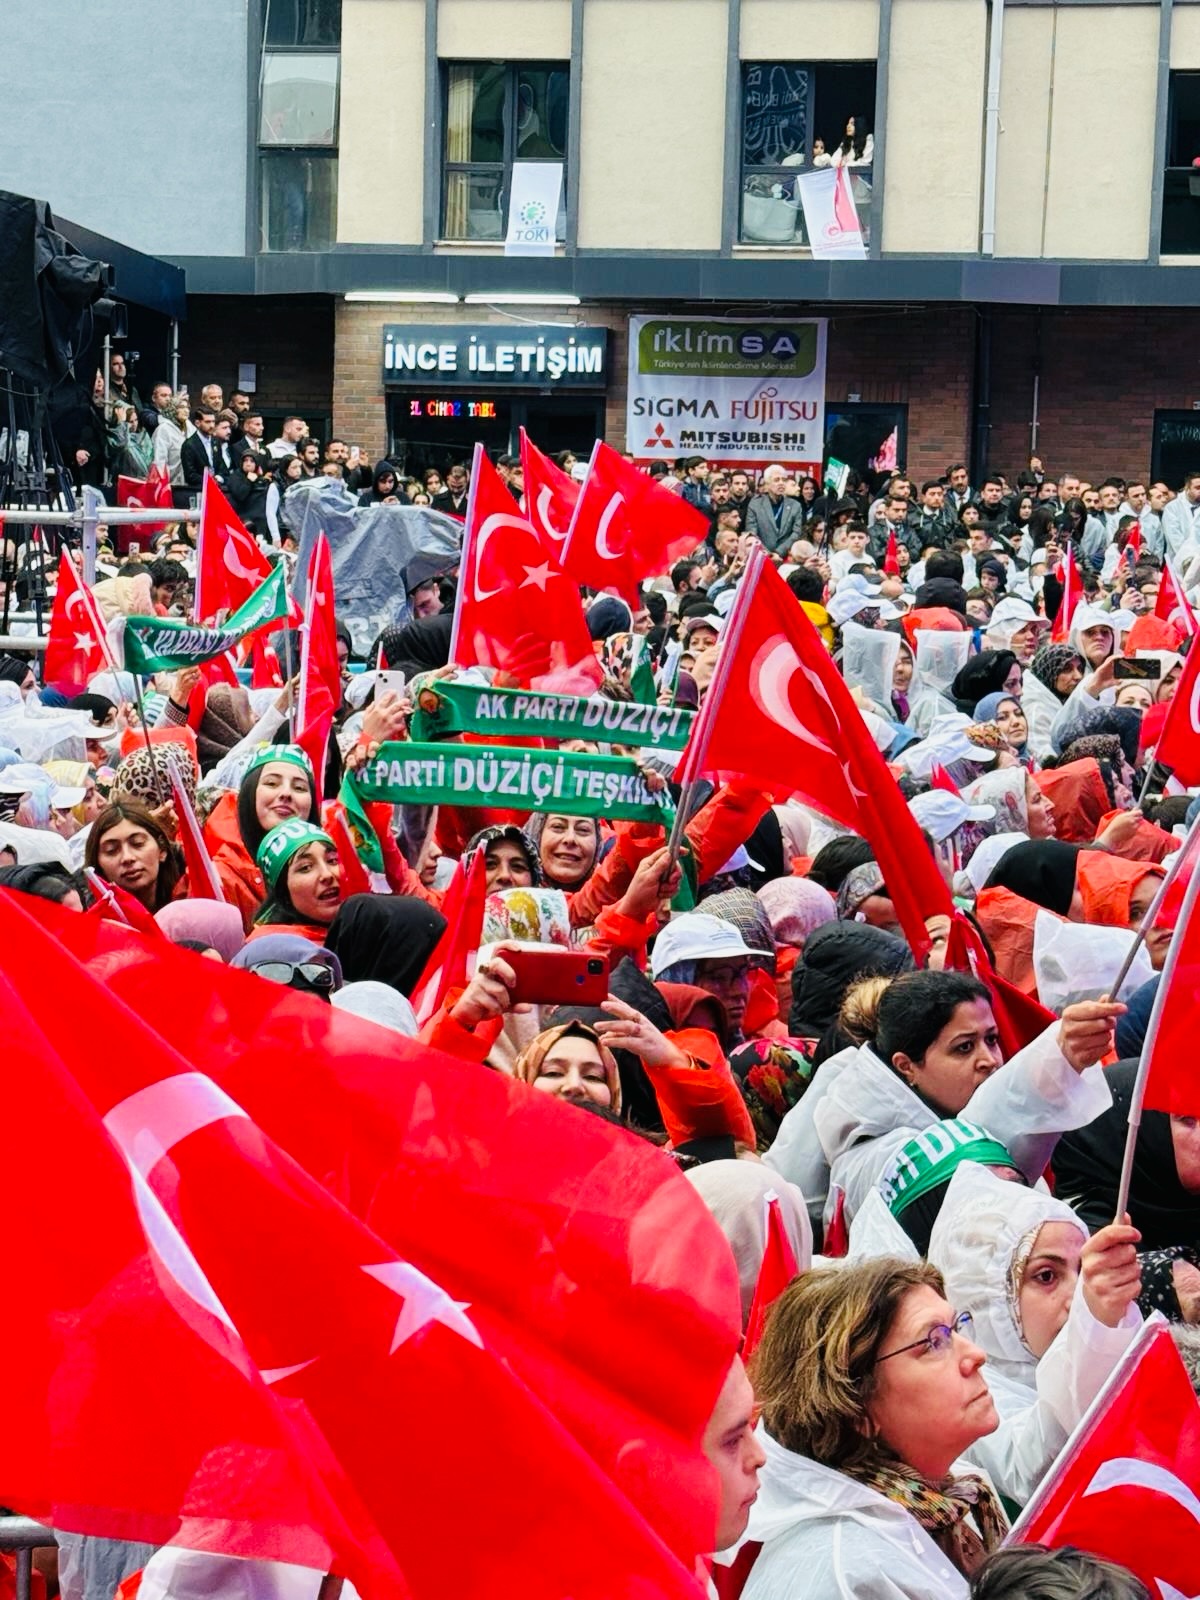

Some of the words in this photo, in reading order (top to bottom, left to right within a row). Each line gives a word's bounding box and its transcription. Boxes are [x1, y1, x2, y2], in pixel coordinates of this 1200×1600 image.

[384, 334, 457, 371] İNCE
[469, 335, 602, 379] İLETİŞİM
[680, 430, 806, 445] MITSUBISHI
[680, 442, 713, 450] HEAVY
[475, 693, 508, 719] AK
[375, 754, 445, 787] PARTİ
[453, 752, 565, 806] DÜZİÇİ
